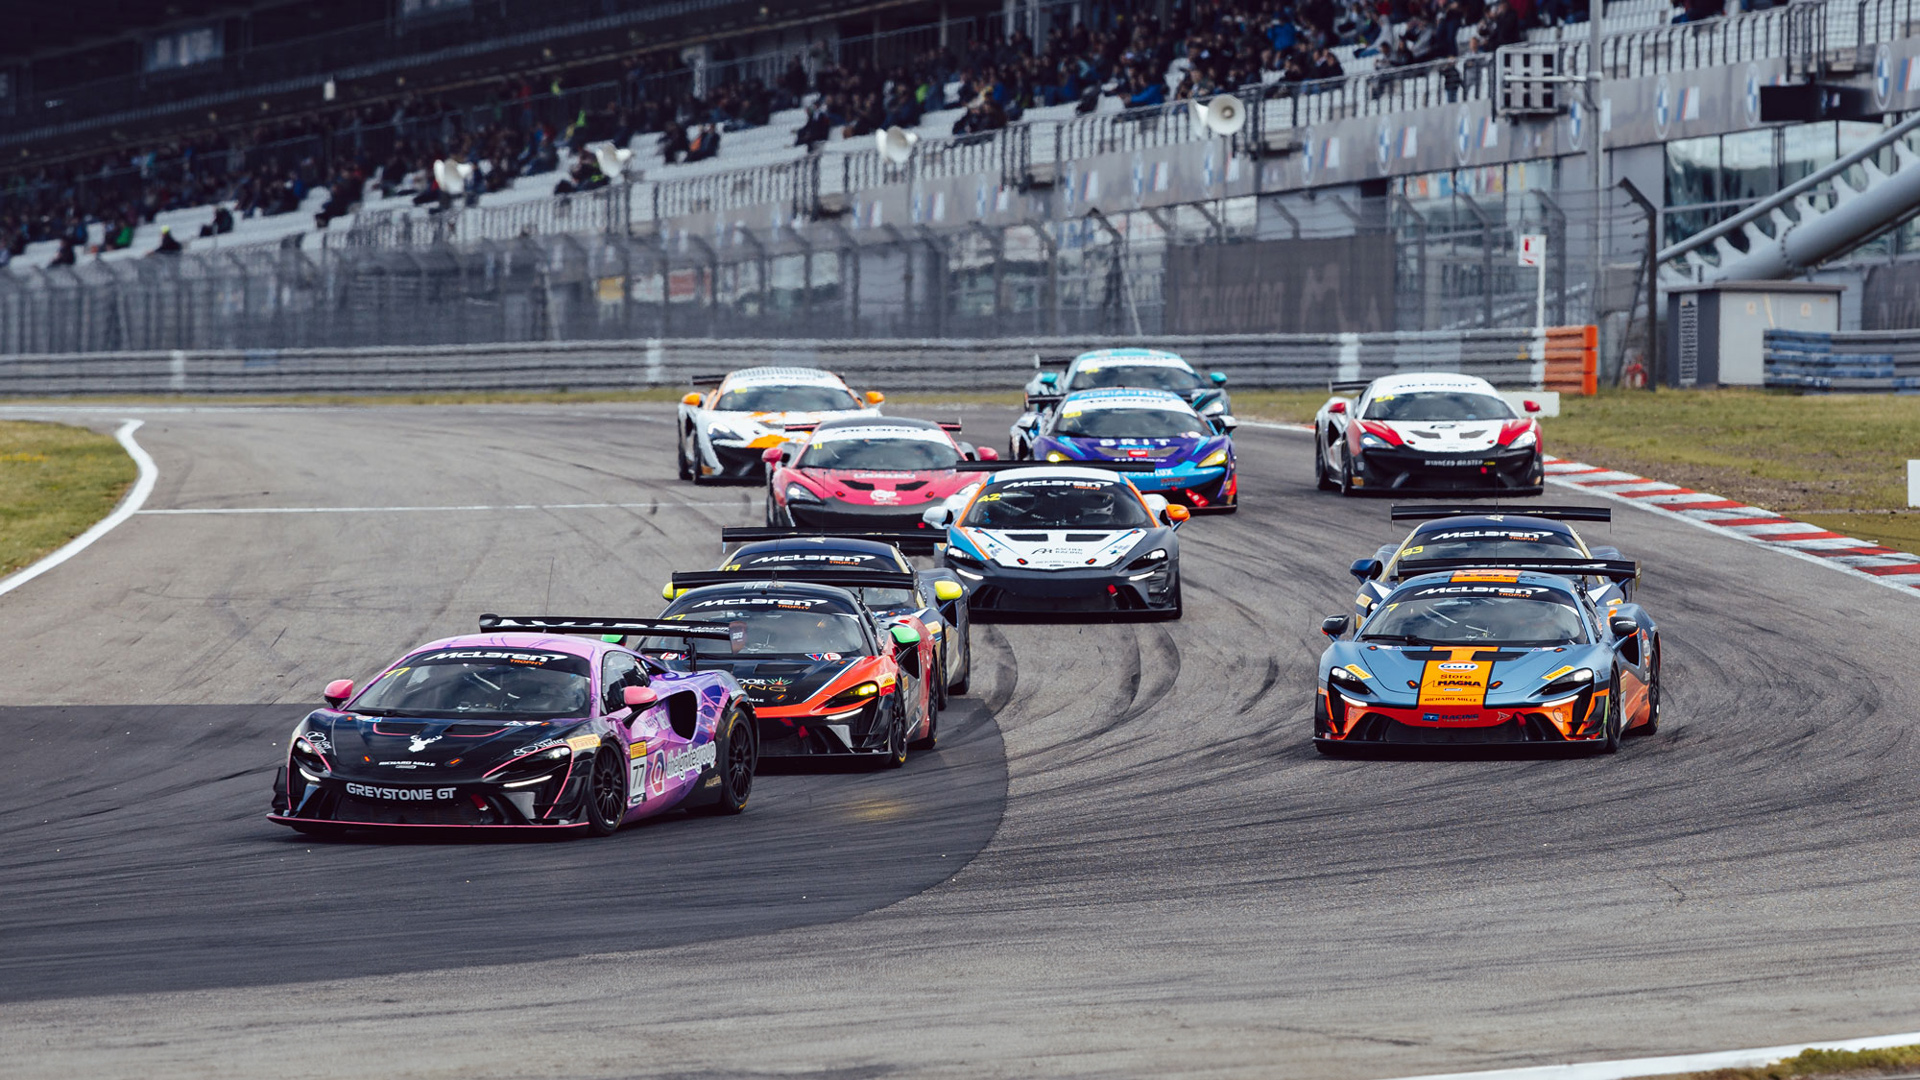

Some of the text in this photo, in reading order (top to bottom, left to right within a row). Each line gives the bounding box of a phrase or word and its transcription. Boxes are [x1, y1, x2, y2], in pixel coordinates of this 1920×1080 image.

[1002, 480, 1114, 489] McLaren
[977, 492, 1001, 502] 42
[1431, 530, 1554, 541] McLaren
[1401, 545, 1424, 557] 93
[749, 554, 876, 564] McLaren
[1414, 586, 1550, 596] McLaren
[692, 598, 828, 608] McLaren
[1386, 602, 1400, 612] 7
[423, 651, 569, 662] McLaren
[510, 658, 544, 666] TROPHY
[742, 684, 787, 692] ING
[632, 763, 645, 789] 77
[346, 782, 457, 801] GREYSTONE GT
